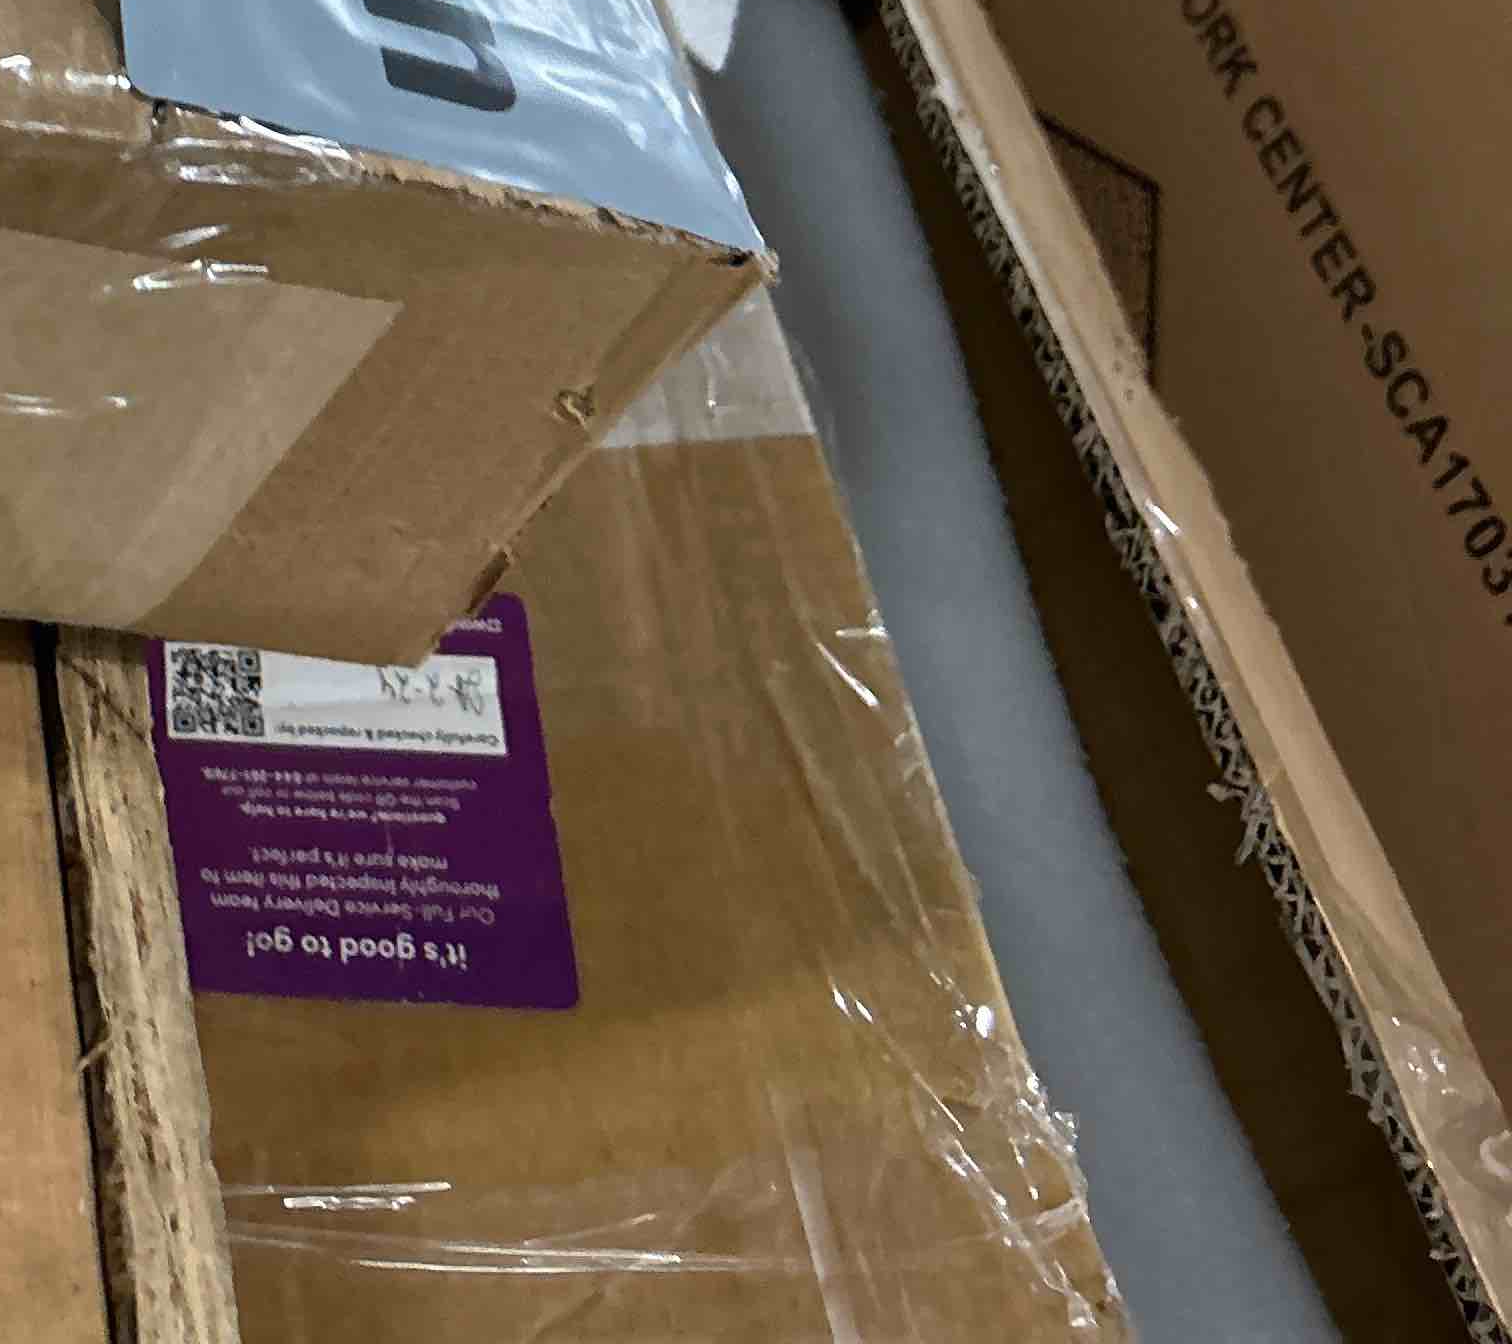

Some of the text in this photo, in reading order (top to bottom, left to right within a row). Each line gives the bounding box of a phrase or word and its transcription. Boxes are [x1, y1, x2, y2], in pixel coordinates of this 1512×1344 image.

[1240, 95, 1512, 626] CENTER-SCA1703
[323, 850, 349, 868] it's
[354, 852, 394, 868] sure
[398, 854, 449, 873] make
[201, 866, 500, 900] thoroughly inspected this item to
[210, 891, 495, 925] Our Full-Service Delivery team
[246, 925, 468, 971] it's good to go!
